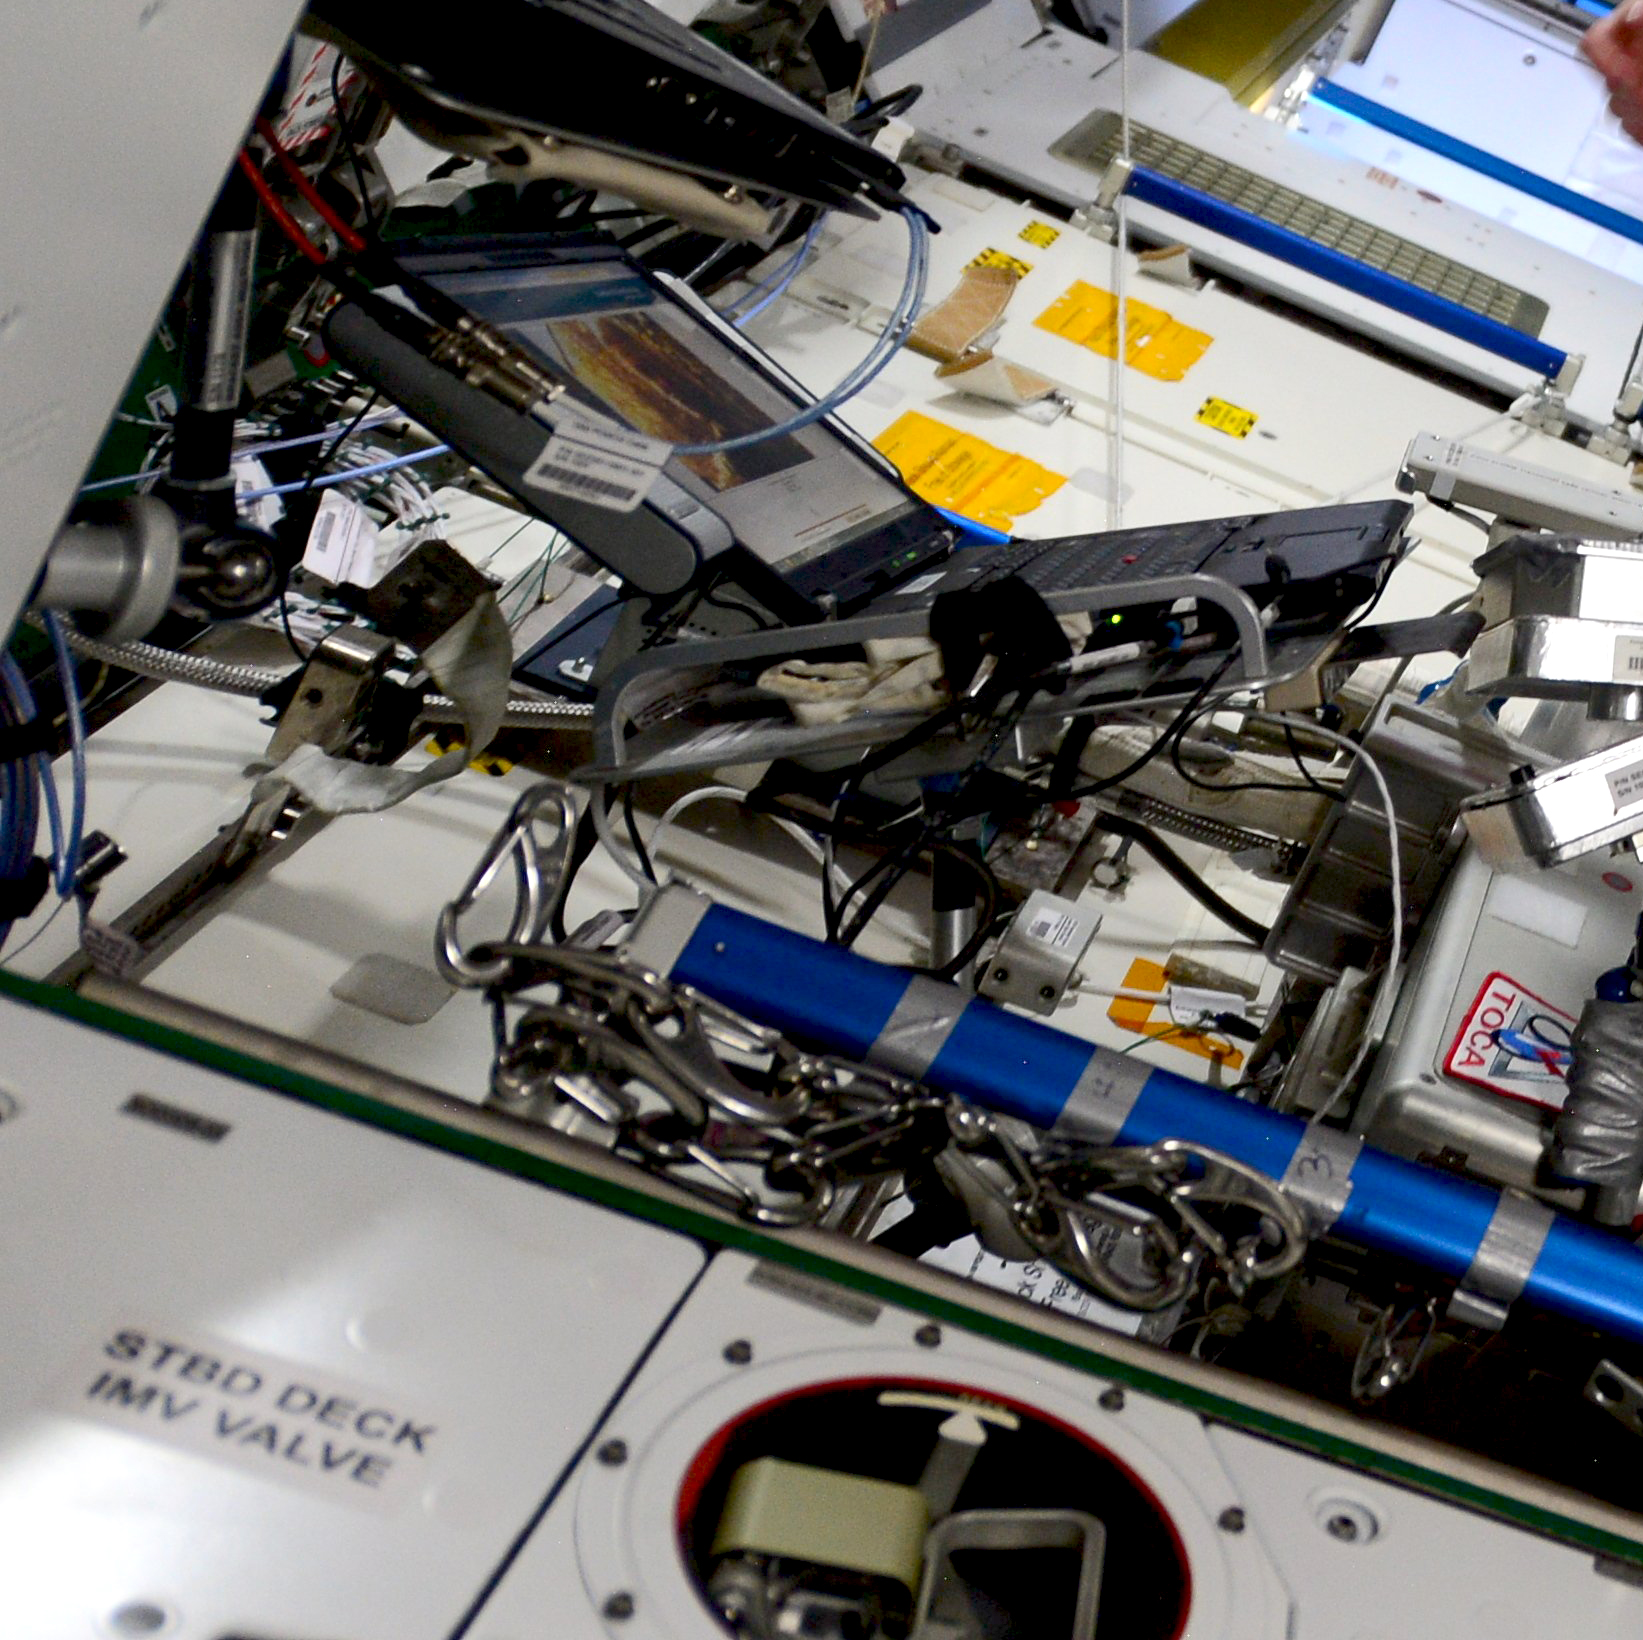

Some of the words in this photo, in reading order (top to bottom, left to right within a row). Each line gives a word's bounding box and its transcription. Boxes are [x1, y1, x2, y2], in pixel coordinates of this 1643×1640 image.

[1457, 990, 1517, 1069] TOCA
[84, 1368, 203, 1424] IMV
[213, 1407, 395, 1490] VALVE
[102, 1328, 264, 1399] STBD
[273, 1384, 440, 1457] DECK
